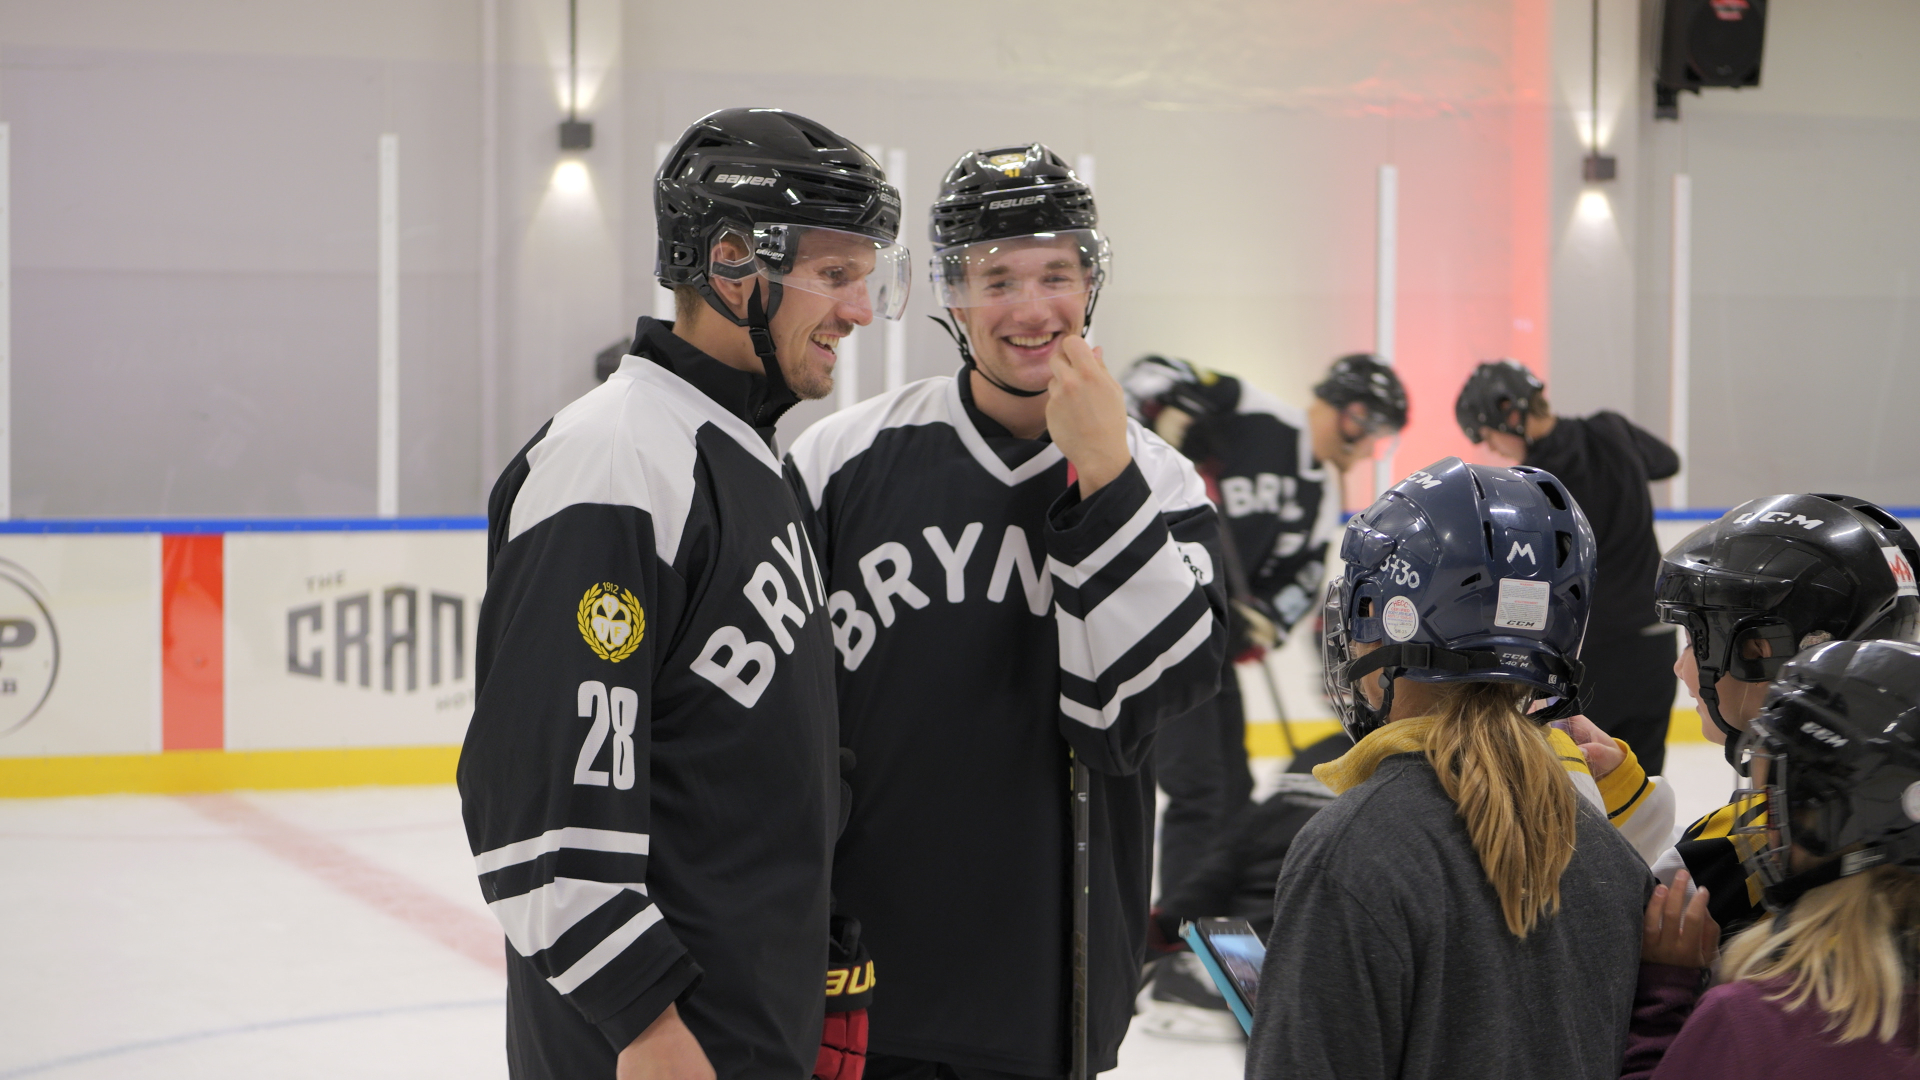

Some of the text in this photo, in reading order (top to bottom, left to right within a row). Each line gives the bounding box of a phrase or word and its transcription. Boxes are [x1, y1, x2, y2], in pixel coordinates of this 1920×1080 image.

[714, 173, 777, 189] BAUER
[988, 194, 1047, 211] BAUER
[1405, 469, 1443, 490] CM
[306, 570, 346, 592] THE
[602, 581, 620, 595] 1912
[1502, 652, 1529, 660] CCM
[573, 680, 639, 791] 28
